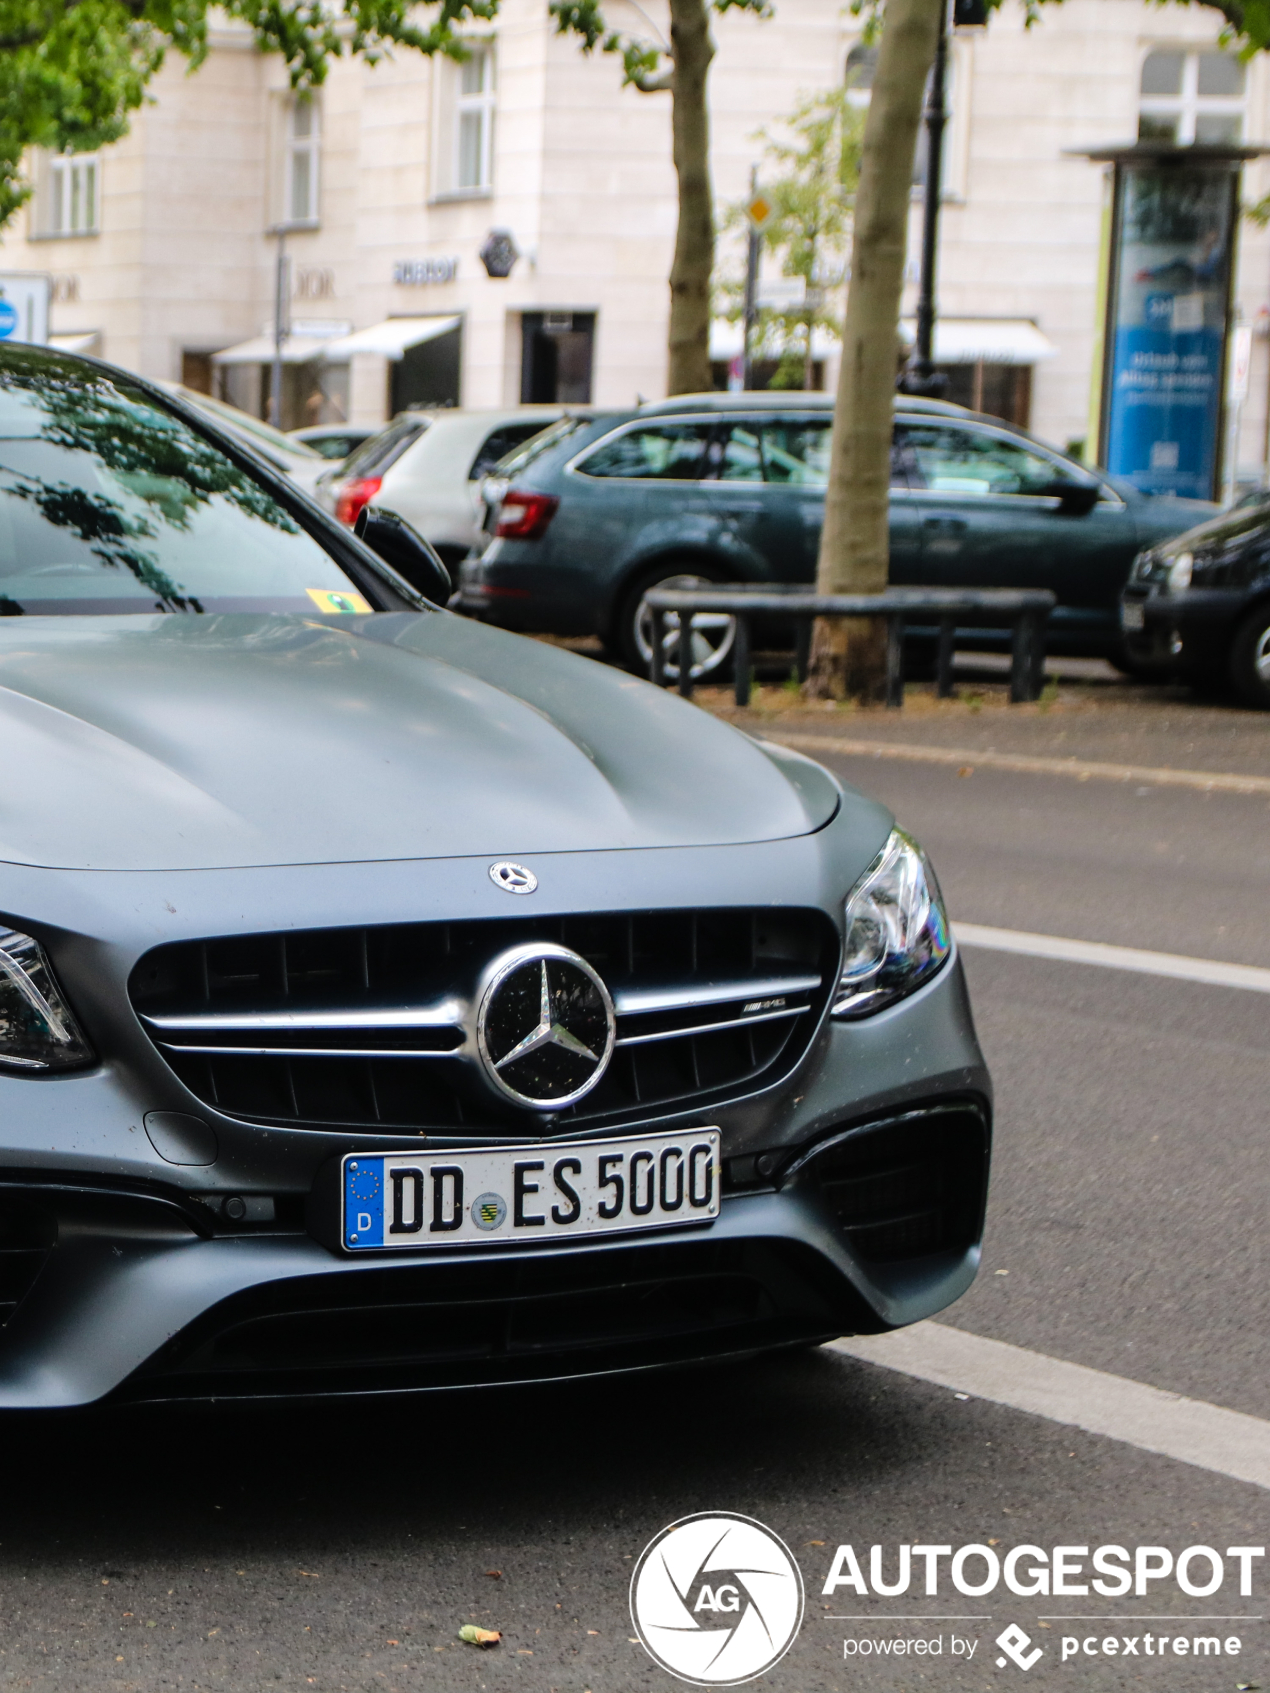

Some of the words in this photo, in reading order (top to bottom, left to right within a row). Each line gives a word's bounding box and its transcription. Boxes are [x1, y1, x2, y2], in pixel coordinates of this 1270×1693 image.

[357, 1211, 372, 1232] D
[389, 1165, 464, 1234] DD
[513, 1157, 582, 1227] ES
[597, 1143, 714, 1219] 5000
